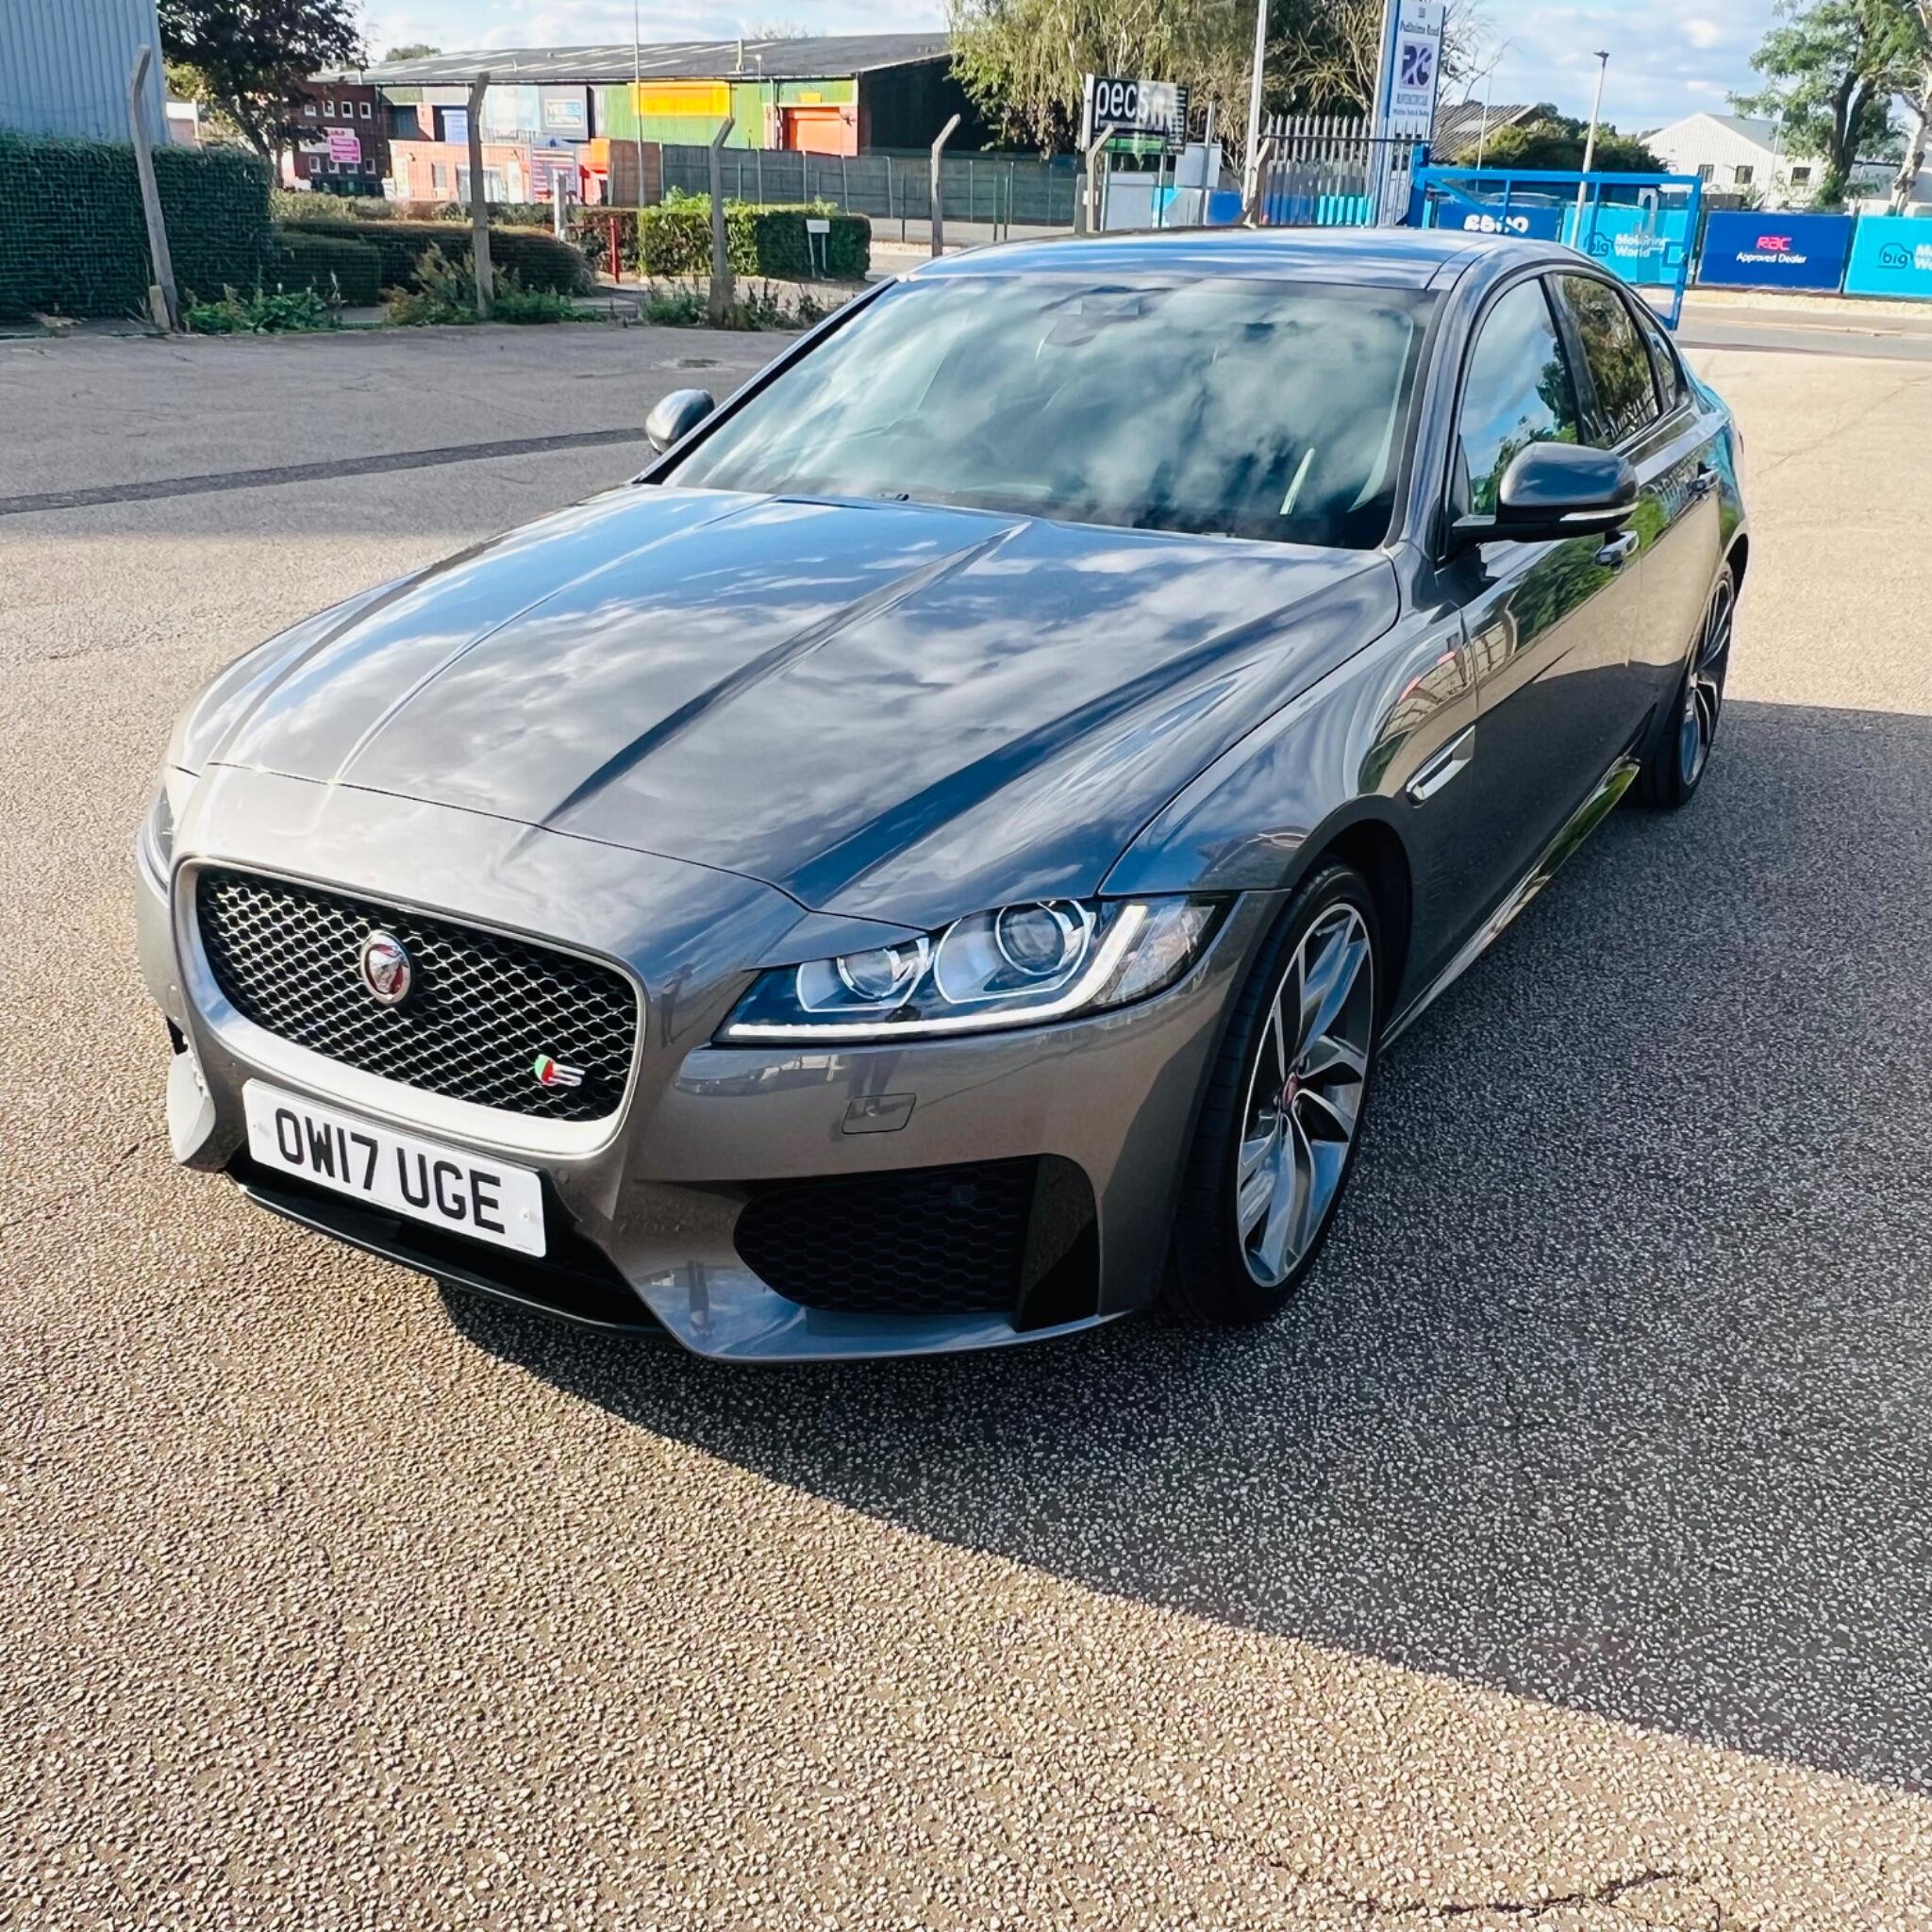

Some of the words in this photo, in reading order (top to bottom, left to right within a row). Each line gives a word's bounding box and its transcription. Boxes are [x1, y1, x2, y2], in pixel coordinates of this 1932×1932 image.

[1615, 245, 1651, 258] World
[1736, 252, 1777, 264] Approved
[1778, 253, 1807, 264] Dealer
[1880, 250, 1907, 270] big
[275, 1107, 378, 1191] OW17
[396, 1146, 506, 1235] UGE
